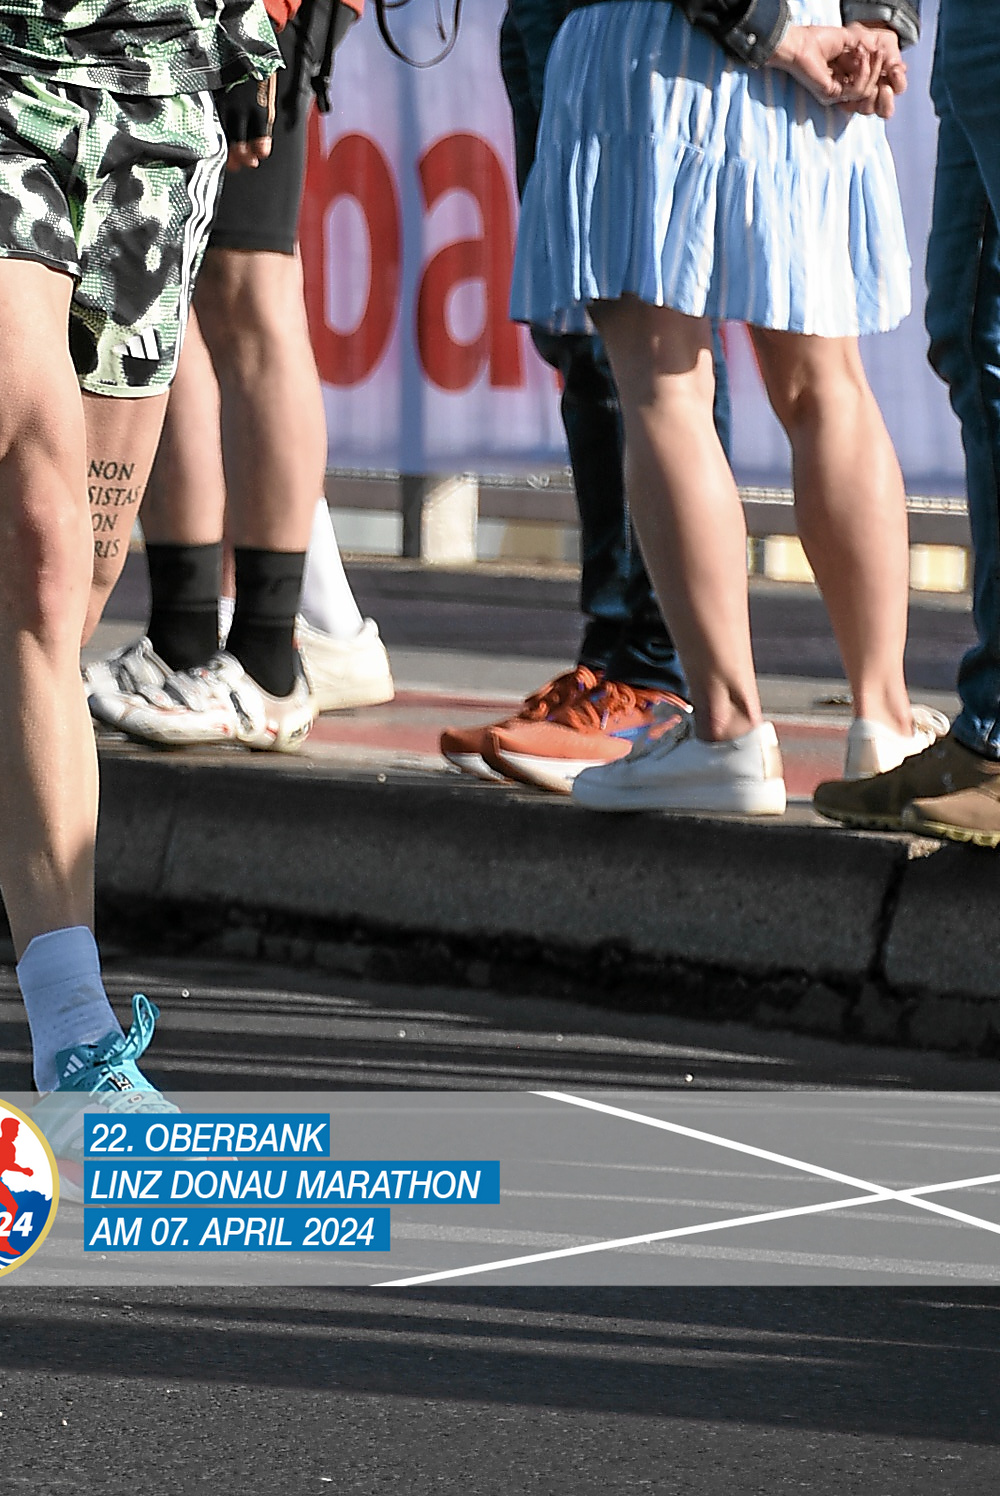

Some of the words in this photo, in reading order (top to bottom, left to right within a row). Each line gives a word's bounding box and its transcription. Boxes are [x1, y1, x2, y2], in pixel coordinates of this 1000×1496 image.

[88, 460, 135, 481] NON
[88, 485, 141, 506] SISTAS
[92, 513, 119, 532] ON
[94, 539, 120, 559] RIS
